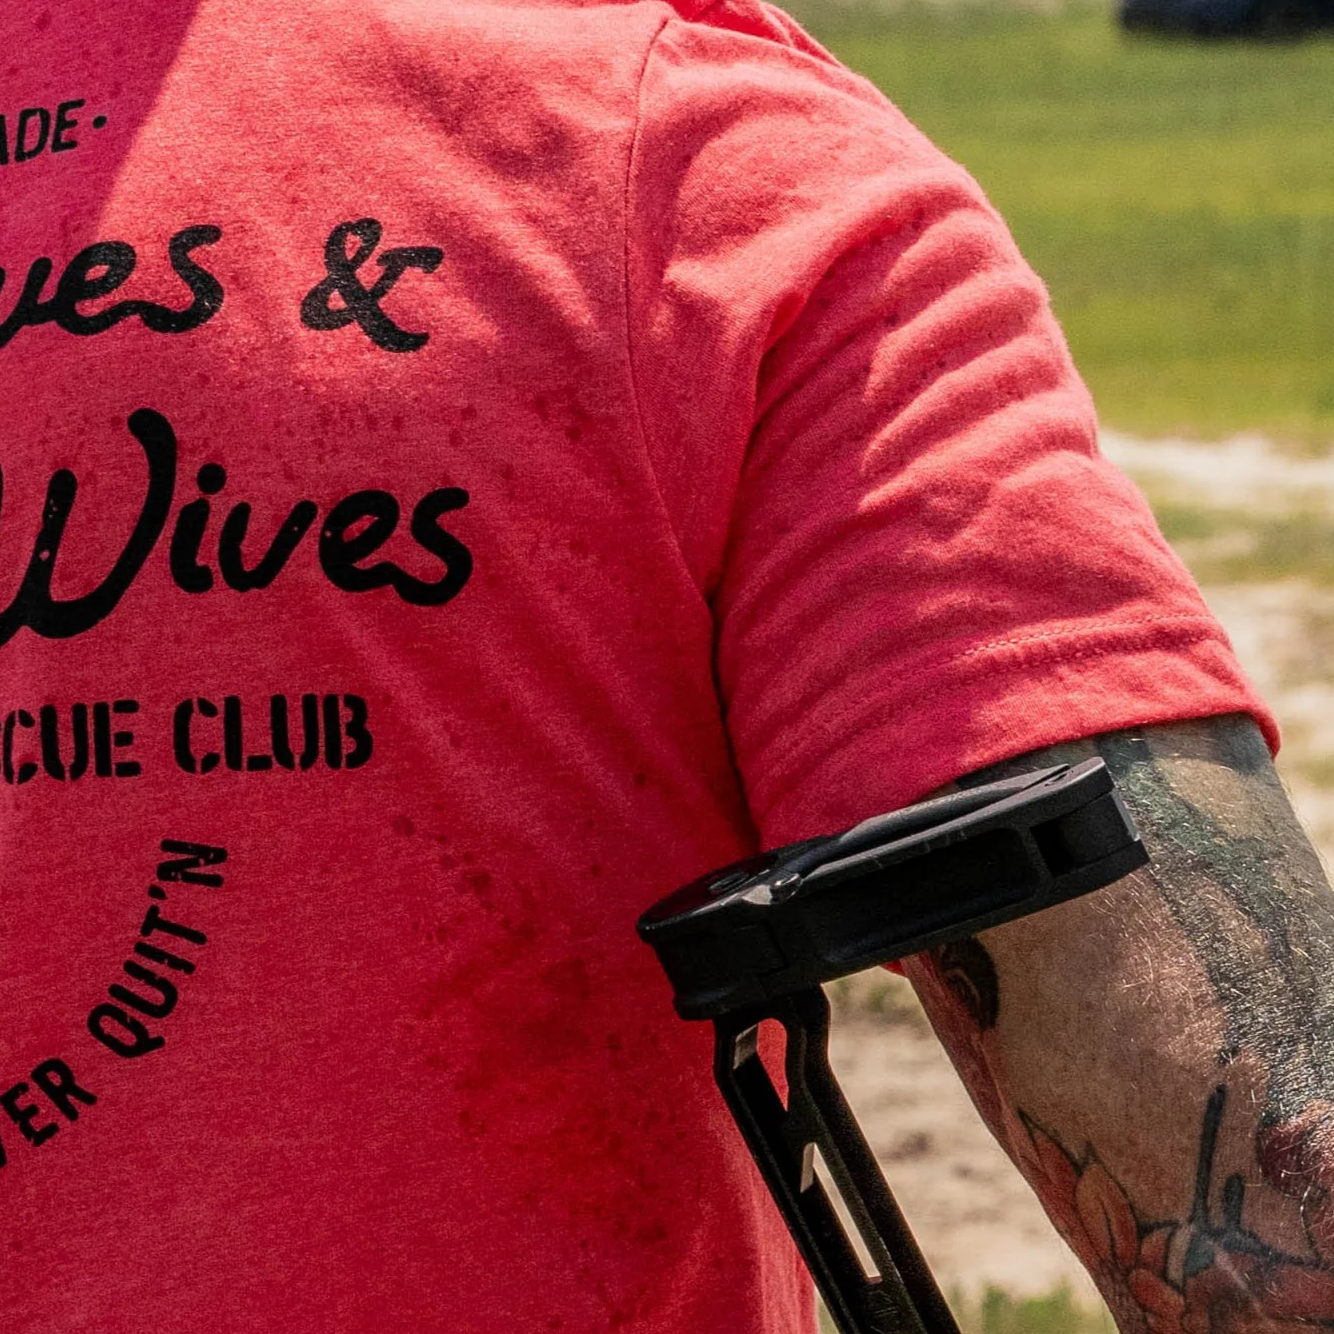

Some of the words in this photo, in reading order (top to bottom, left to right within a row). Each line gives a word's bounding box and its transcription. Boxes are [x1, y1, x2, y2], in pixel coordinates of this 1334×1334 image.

[301, 218, 444, 353] &
[173, 693, 374, 774] CLUB
[87, 838, 228, 1059] QUIT'N
